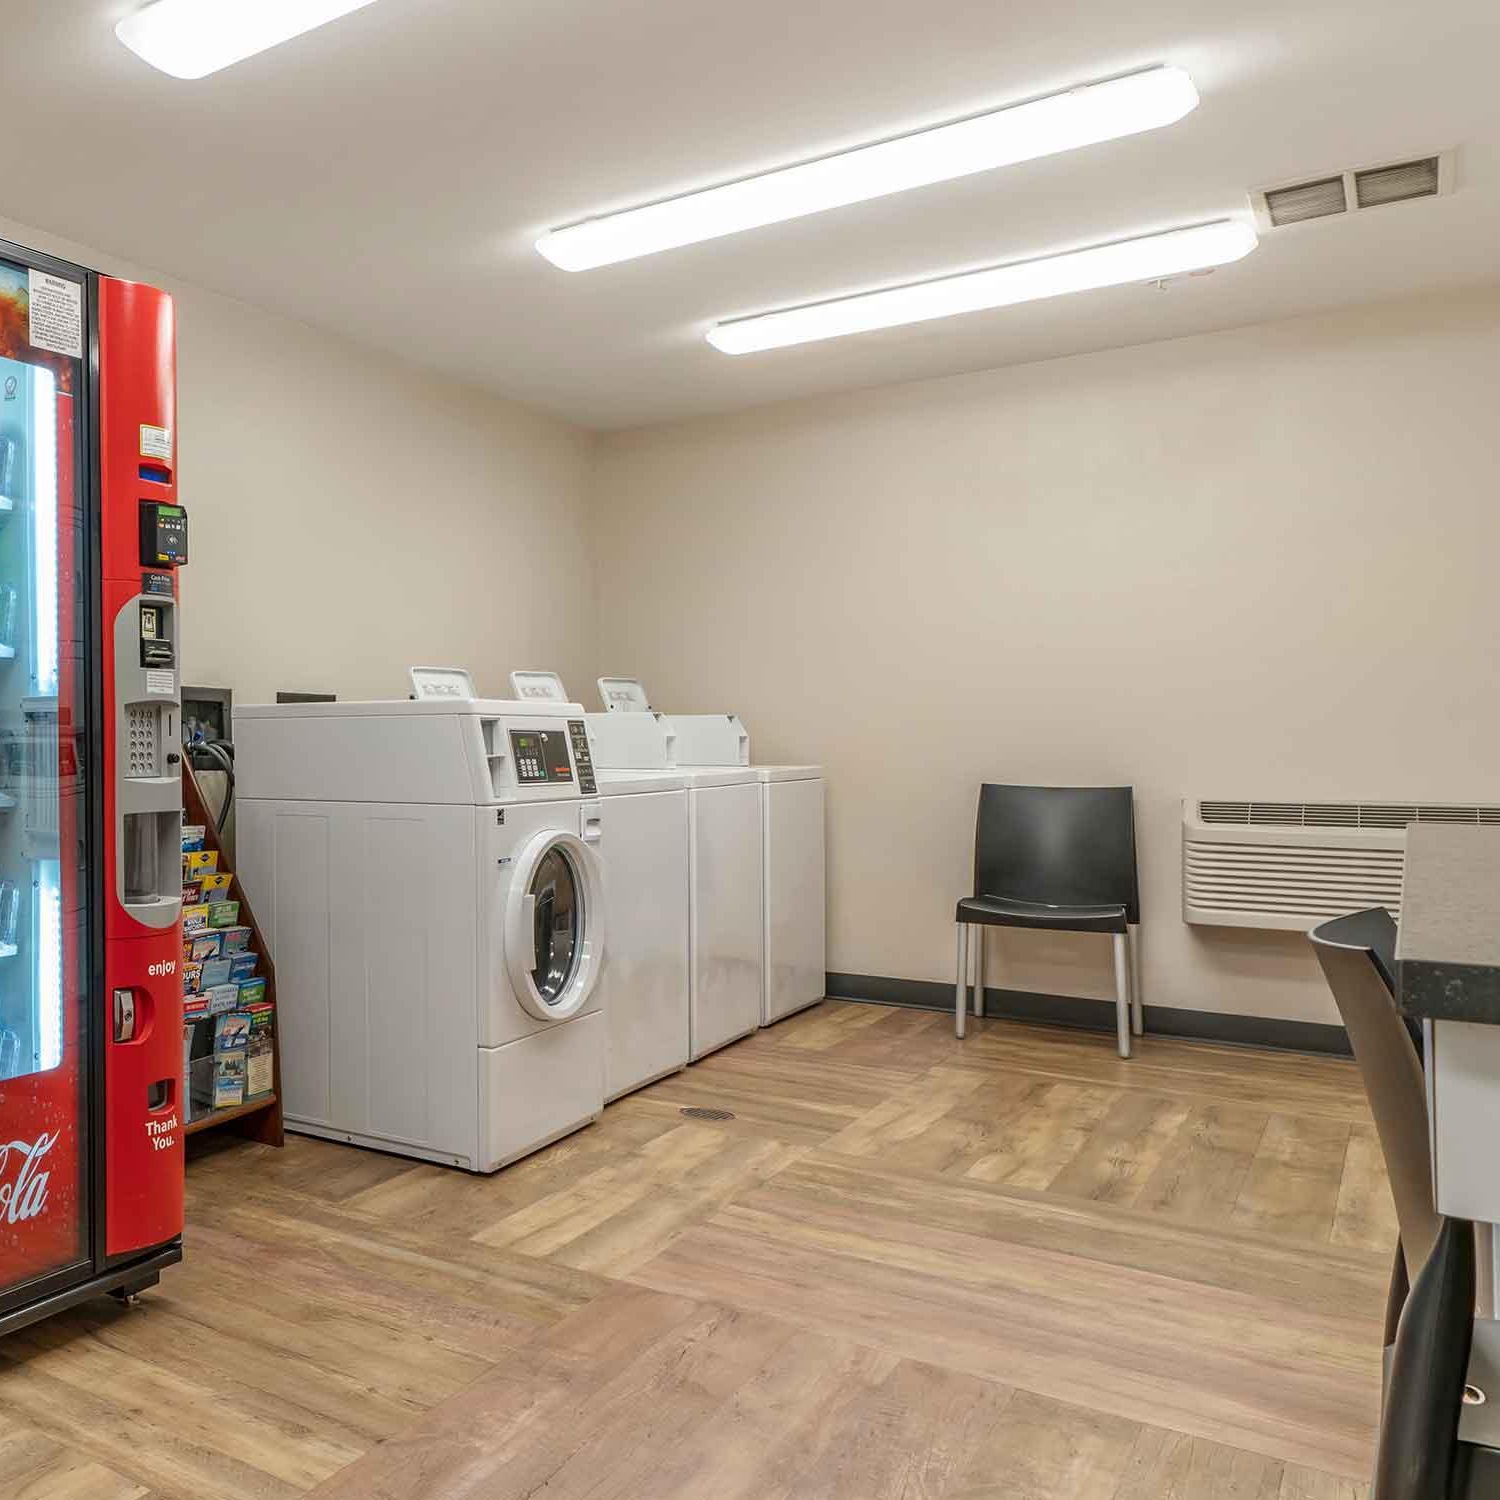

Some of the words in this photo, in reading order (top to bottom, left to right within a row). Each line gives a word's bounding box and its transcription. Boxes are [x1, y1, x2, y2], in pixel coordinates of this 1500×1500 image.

[148, 960, 176, 977] enjoy
[145, 1114, 178, 1137] Thank
[153, 1136, 175, 1151] You.
